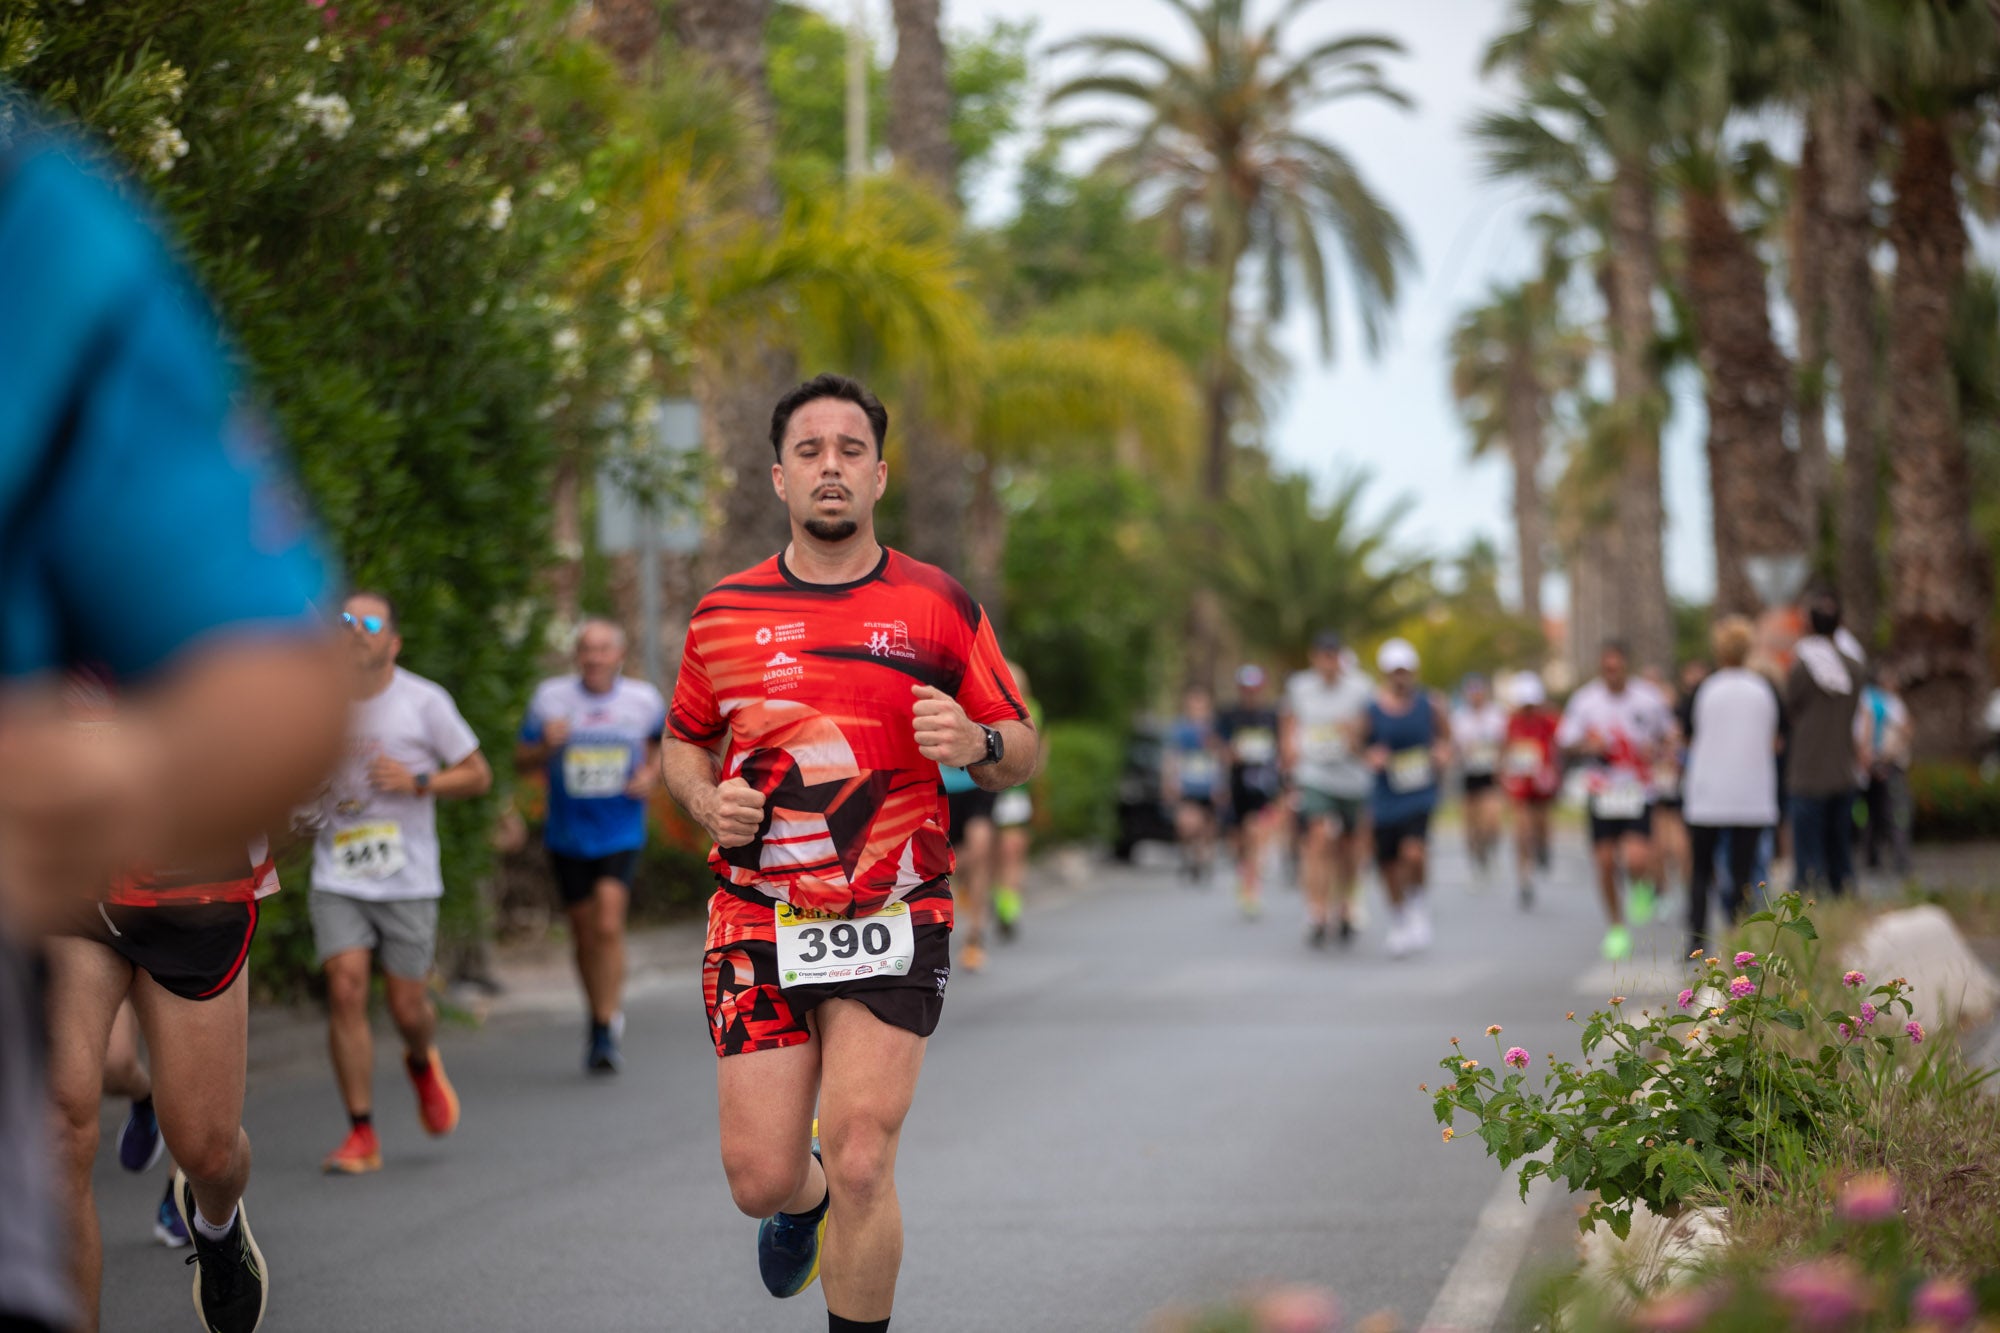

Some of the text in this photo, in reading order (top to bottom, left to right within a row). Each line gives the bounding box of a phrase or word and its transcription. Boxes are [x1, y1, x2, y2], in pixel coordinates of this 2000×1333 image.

[889, 650, 916, 660] ALBOLOTE
[762, 666, 804, 682] ALBOLOTE
[767, 682, 799, 694] DEPORTES
[798, 922, 892, 963] 390
